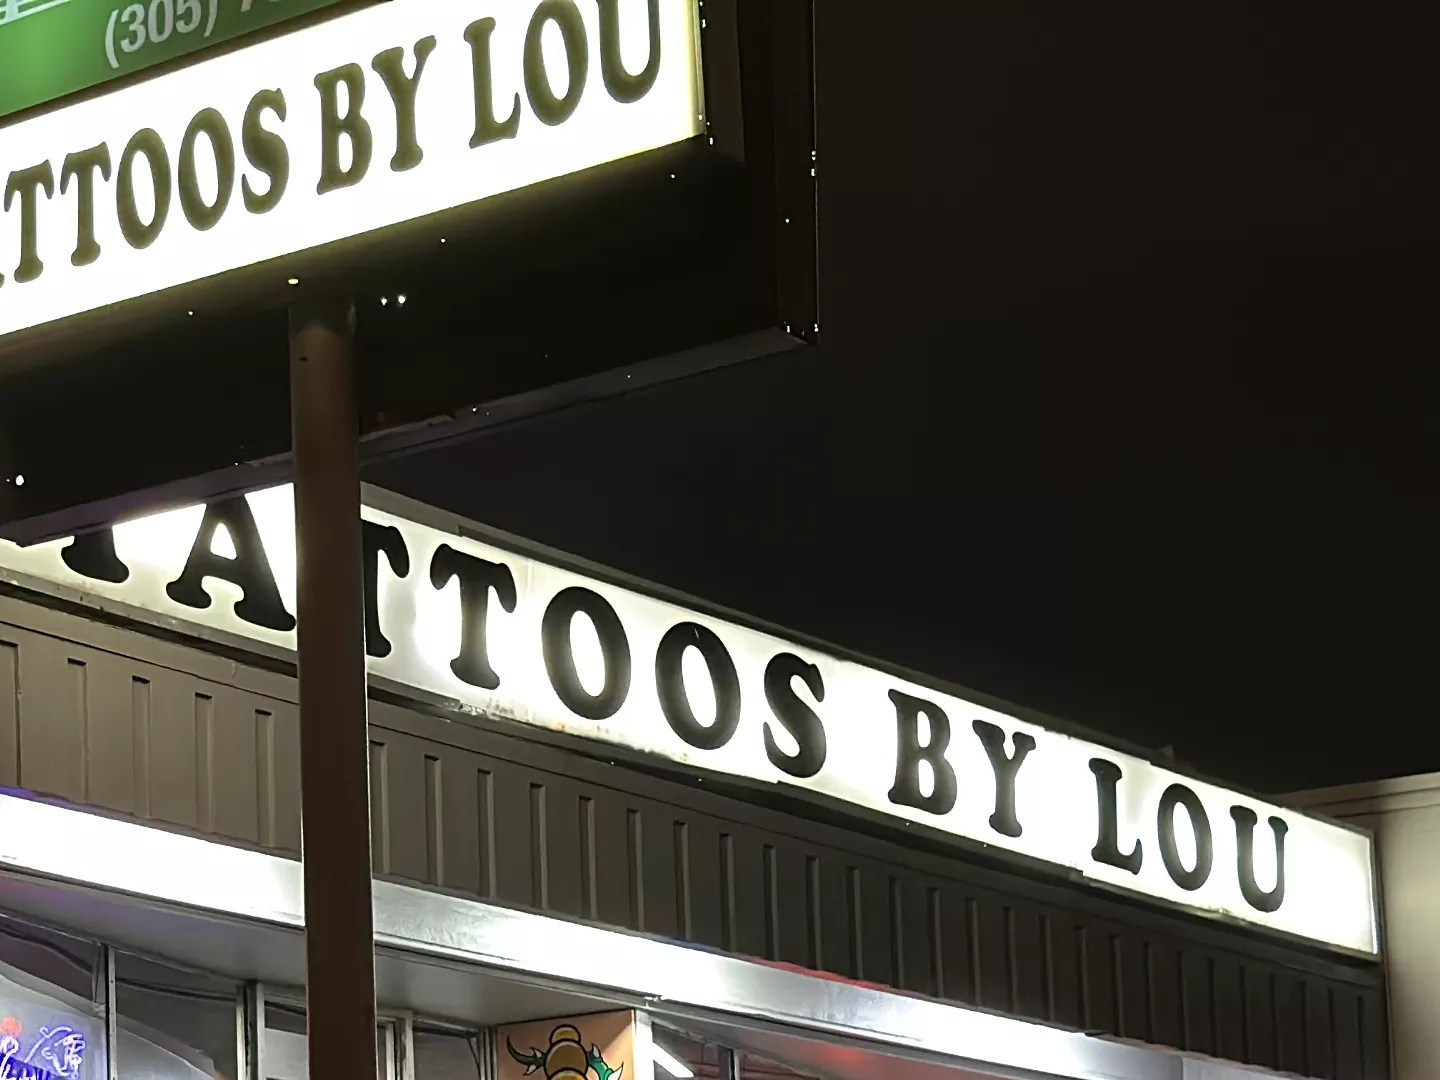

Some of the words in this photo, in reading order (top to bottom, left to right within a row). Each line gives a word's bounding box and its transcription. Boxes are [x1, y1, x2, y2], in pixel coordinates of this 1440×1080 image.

[313, 34, 437, 196] BY
[464, 0, 662, 150] LOU
[887, 688, 1038, 839] BY
[1089, 757, 1291, 913] LOU
